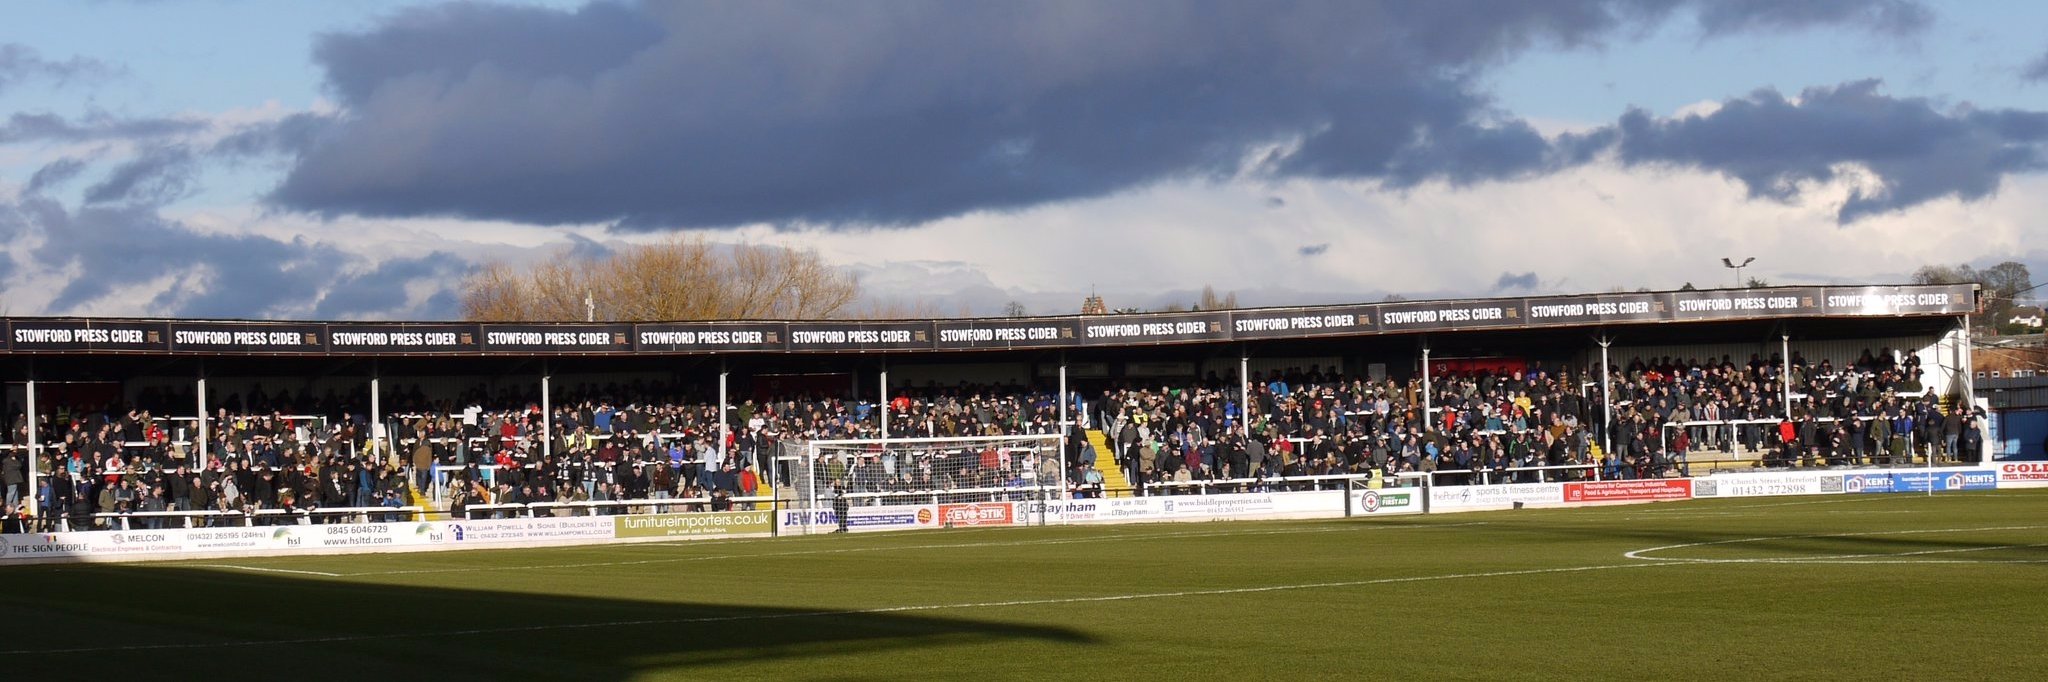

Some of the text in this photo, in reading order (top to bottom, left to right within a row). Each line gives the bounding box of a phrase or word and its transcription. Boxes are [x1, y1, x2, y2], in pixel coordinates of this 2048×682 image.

[1679, 297, 1798, 312] STOWFORD PRESS CIDER
[1828, 293, 1949, 307] STOWFO PRESS CIDER
[1384, 307, 1502, 324] STOWFORD PRESS CIDER
[1531, 302, 1649, 318] STOWFORD PRESS CIDER
[1087, 321, 1206, 338] STOWFORD PRESS CIDER
[1235, 314, 1355, 332] STOWFORD PRESS CIDER
[15, 329, 144, 343] STOWFORD PRESS CIDER
[175, 331, 301, 345] STOWFORD PRESS CIDER
[332, 332, 457, 346] STOWFORD PRESS CIDER
[487, 332, 610, 346] STOWFORD PRESS CIDER
[641, 331, 762, 345] STOWFORD PRESS CIDER
[793, 330, 911, 344] STOWFORD PRESS CIDER
[940, 327, 1058, 342] STOWFORD PRESS CIDER
[1865, 477, 1894, 486] KENTS
[1965, 475, 1995, 483] KENTS
[1476, 488, 1500, 496] sports
[1509, 485, 1534, 494] fitness
[1536, 485, 1560, 493] centre
[1732, 485, 1806, 495] 01432 272898
[624, 513, 768, 529] furnitureimporters.co.uk
[351, 525, 388, 534] 6046729
[430, 532, 443, 541] hsl
[128, 534, 165, 543] MELCON
[287, 537, 301, 545] hsl
[324, 536, 392, 545] www.hsltd.com
[13, 545, 31, 553] THE
[32, 544, 53, 553] SIGN
[56, 543, 88, 552] PEOPLE
